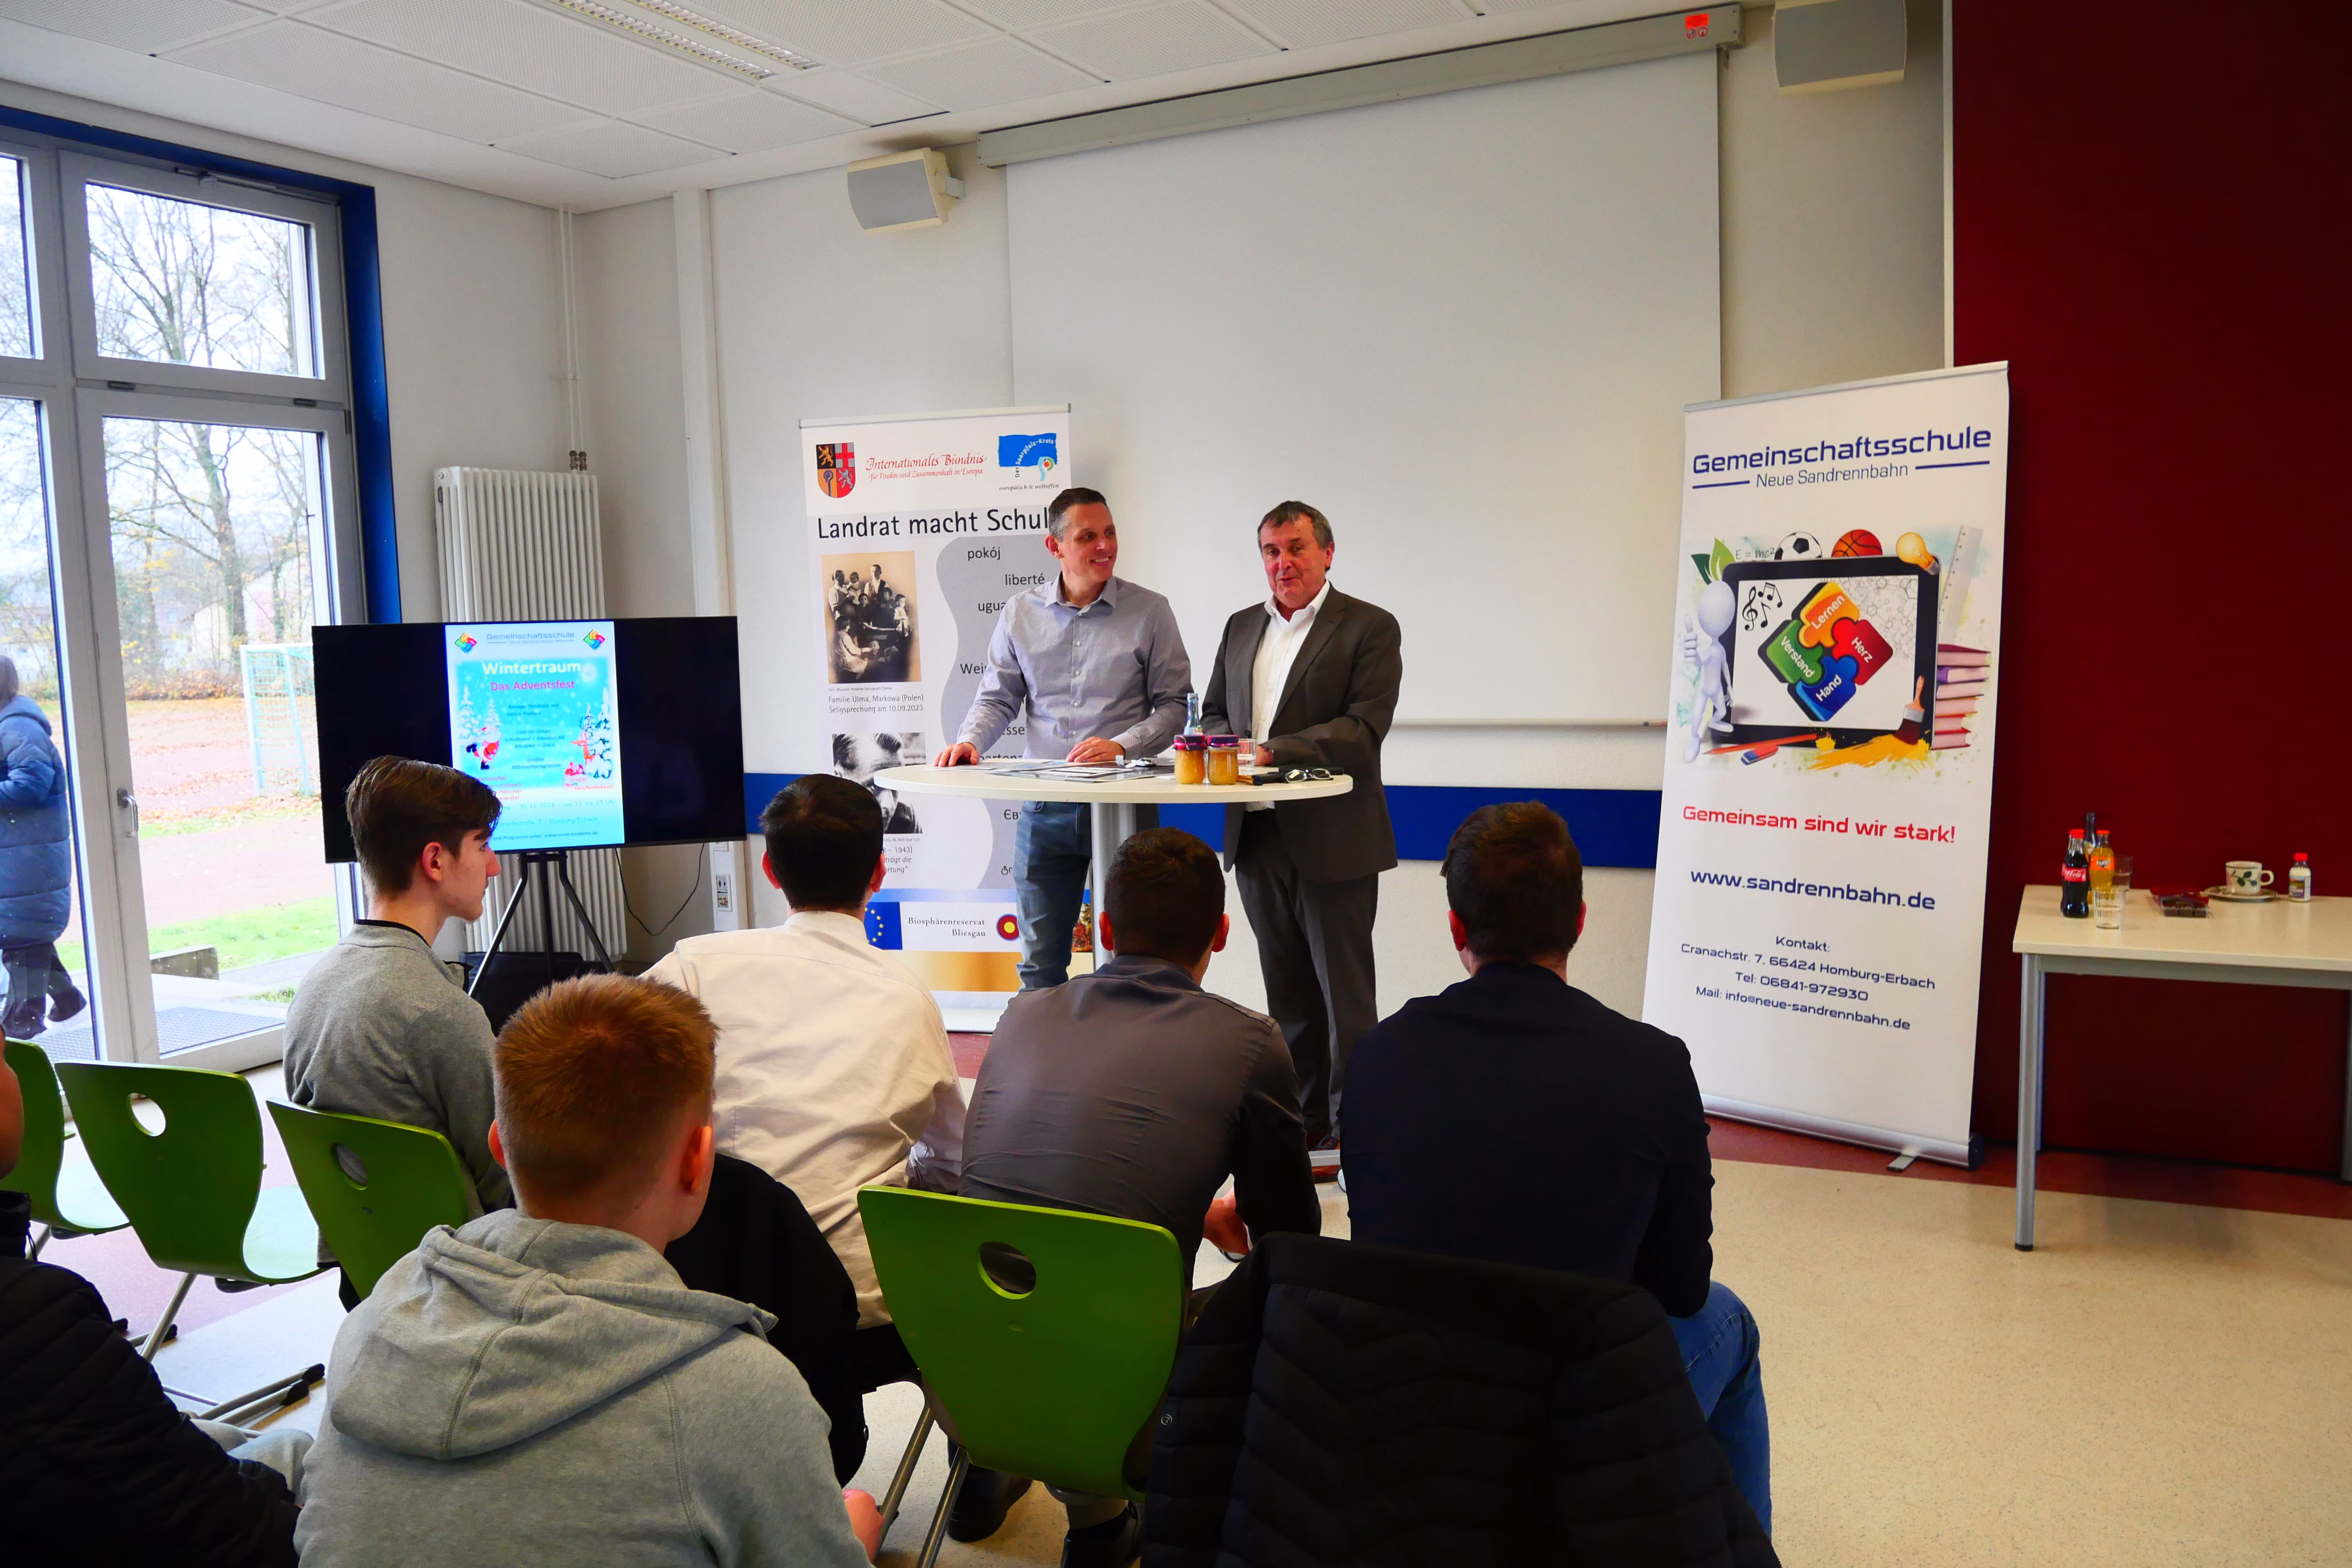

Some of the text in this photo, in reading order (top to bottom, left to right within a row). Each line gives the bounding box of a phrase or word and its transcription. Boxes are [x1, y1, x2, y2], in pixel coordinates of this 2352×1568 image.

[866, 453, 987, 471] Internationales Bündnis
[1015, 438, 1054, 466] Saarpfalz-Kreis
[1693, 426, 1992, 474] Gemeinschaftsschule
[869, 473, 878, 483] für
[880, 471, 898, 480] Frieden
[912, 468, 953, 478] Zusammenhalt
[960, 468, 983, 477] Europa
[1756, 463, 1909, 488] Neue Sandrennbahn
[818, 507, 1049, 539] Landrat macht Schul
[968, 547, 1000, 561] pokój
[1005, 573, 1044, 585] liberté
[978, 602, 1006, 614] ugua
[1811, 595, 1845, 629] Lernen
[1780, 635, 1815, 679] Verstand
[1851, 637, 1873, 663] Herz
[482, 662, 581, 675] Wintertraum
[491, 680, 575, 691] Das Adventsfest
[902, 694, 924, 702] (Polen)
[1816, 674, 1842, 702] Hand
[829, 706, 876, 714] Seligsprechung
[1683, 806, 1955, 843] Gemeinsam sind wir stark!
[1690, 871, 1936, 911] www.sandrennbahn.de
[908, 917, 985, 926] Biosphärenreservat
[952, 929, 986, 939] Bliesgau
[1775, 936, 1830, 953] Kontakt:
[1681, 944, 1936, 990] Cranachstr. 7, 66424 Homburg-Erbach
[1735, 972, 1868, 1001] Tel: 06841-972930
[1696, 986, 1911, 1030] Mail: info@neue-sandrennbahn.de
